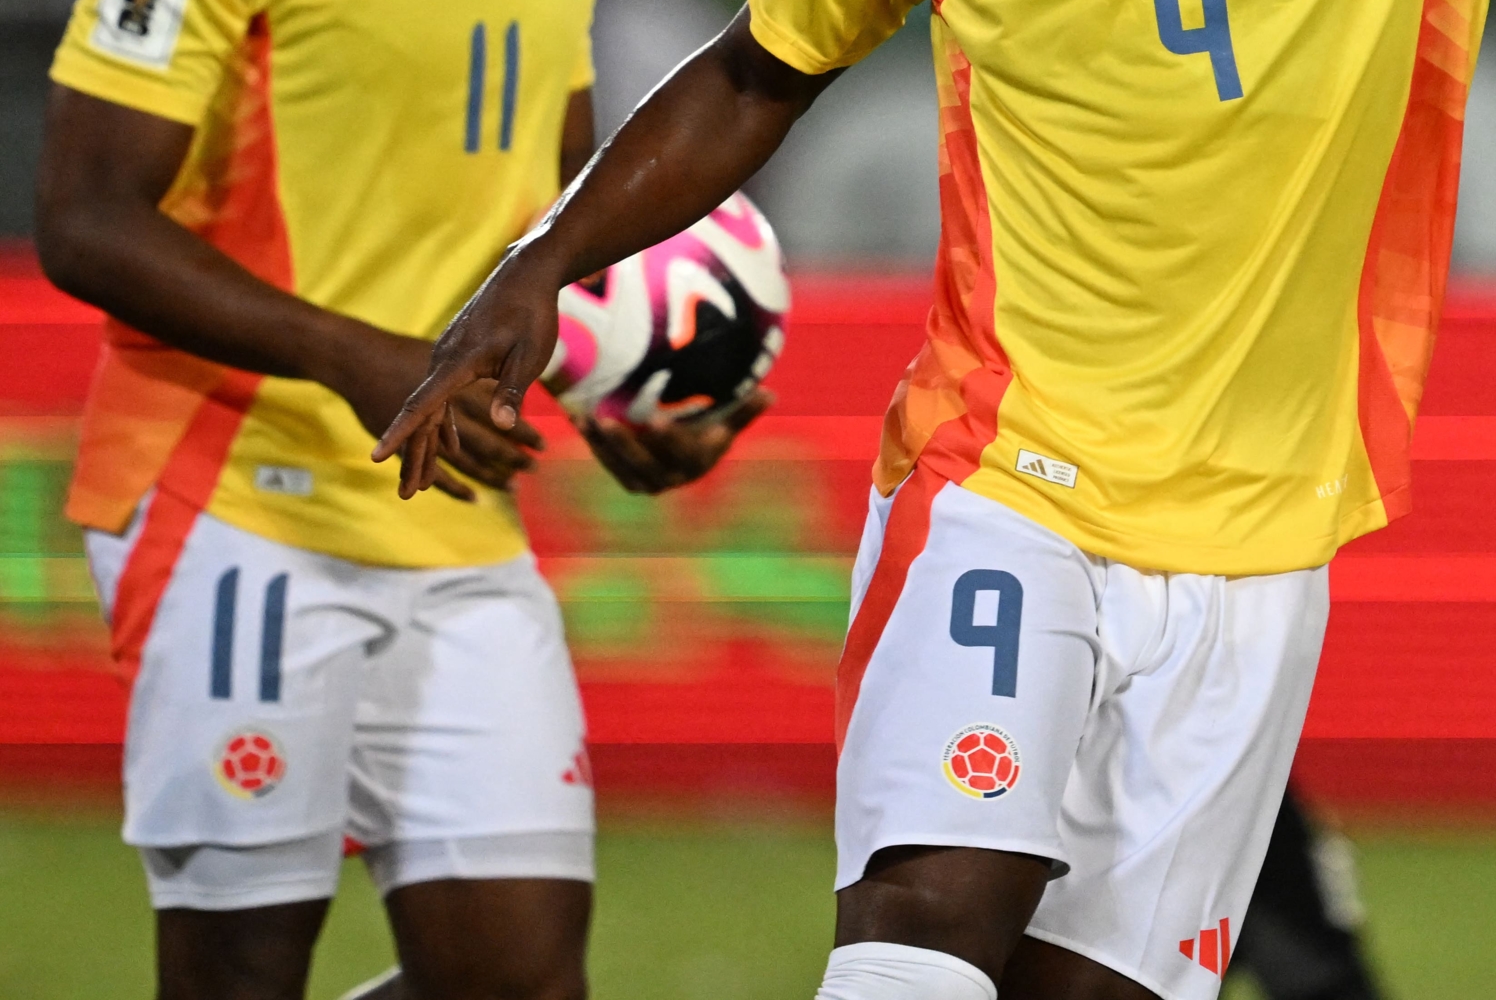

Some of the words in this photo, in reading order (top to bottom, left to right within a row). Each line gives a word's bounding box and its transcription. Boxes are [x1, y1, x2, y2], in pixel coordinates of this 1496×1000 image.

[464, 21, 521, 153] 11
[209, 565, 289, 703] 11
[950, 569, 1024, 699] 9
